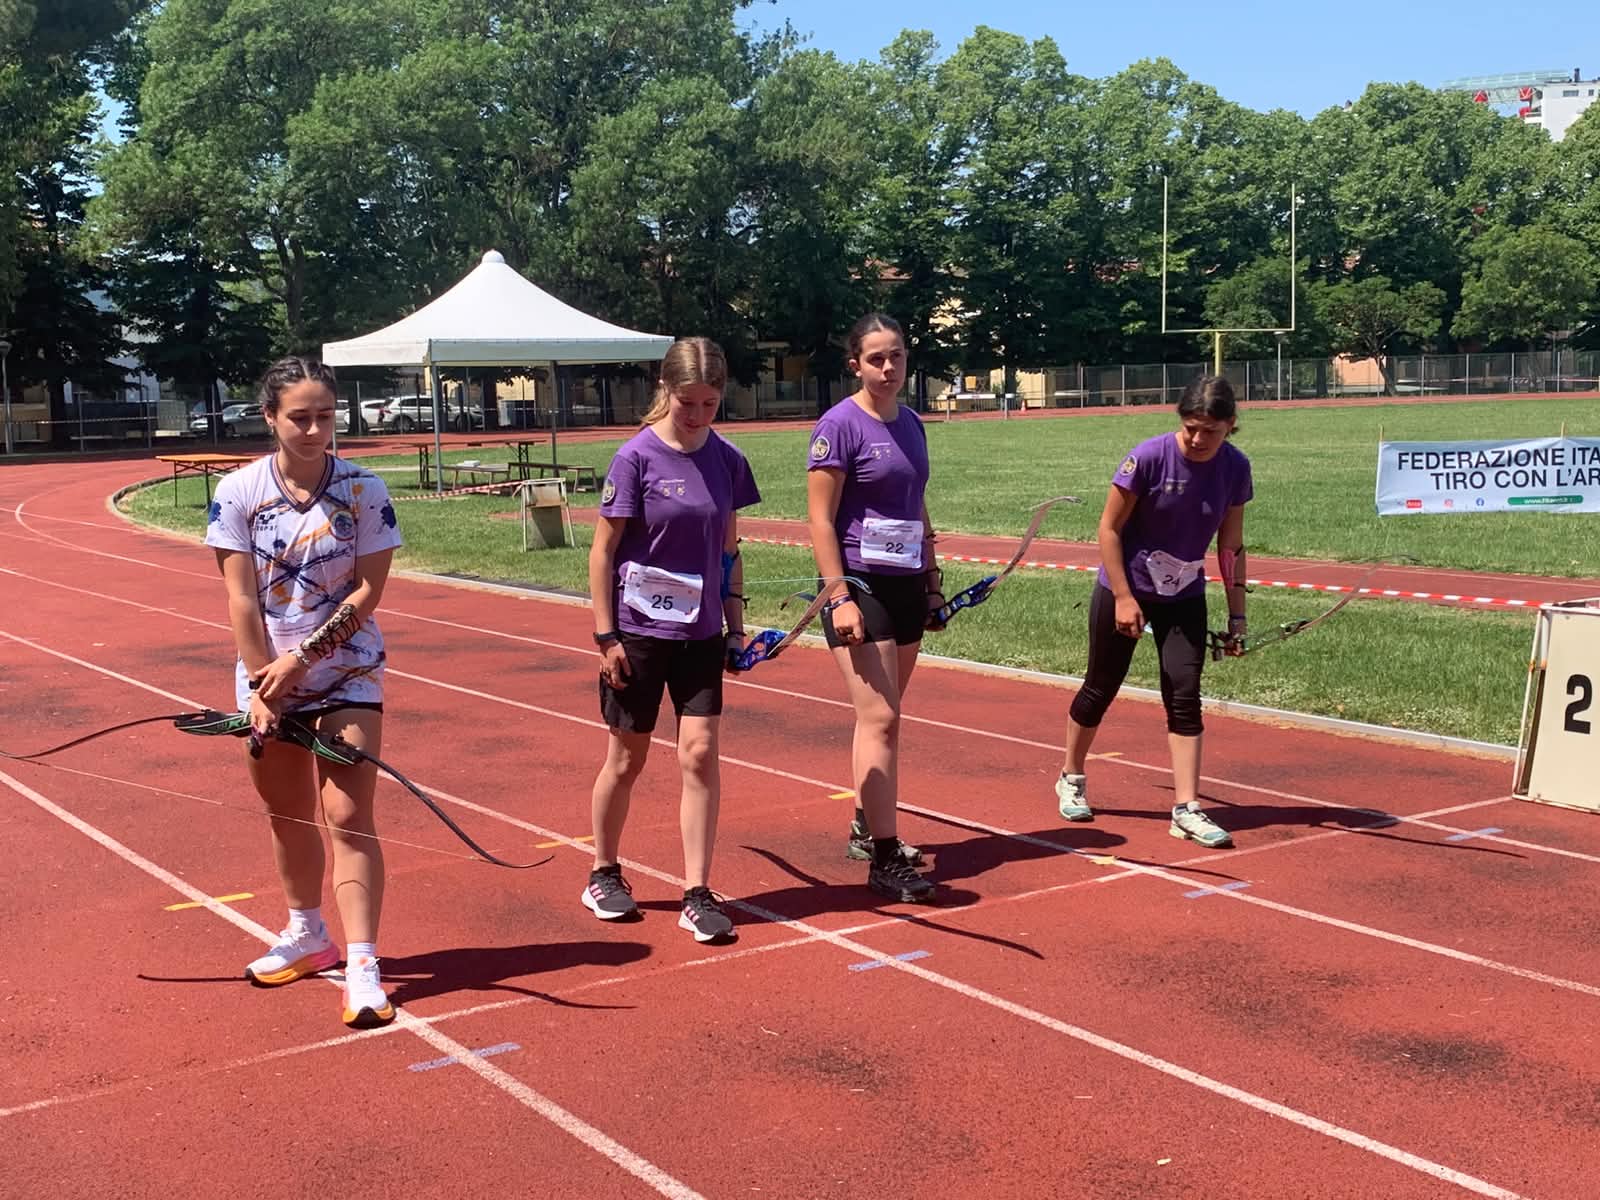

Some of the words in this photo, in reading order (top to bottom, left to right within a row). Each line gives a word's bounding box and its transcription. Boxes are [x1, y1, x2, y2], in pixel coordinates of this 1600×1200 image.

[1398, 448, 1564, 470] FEDERAZIONE
[1431, 471, 1486, 490] TIRO
[1494, 469, 1547, 488] CON
[885, 542, 904, 554] 22
[651, 595, 673, 610] 25
[1564, 674, 1593, 734] 2
